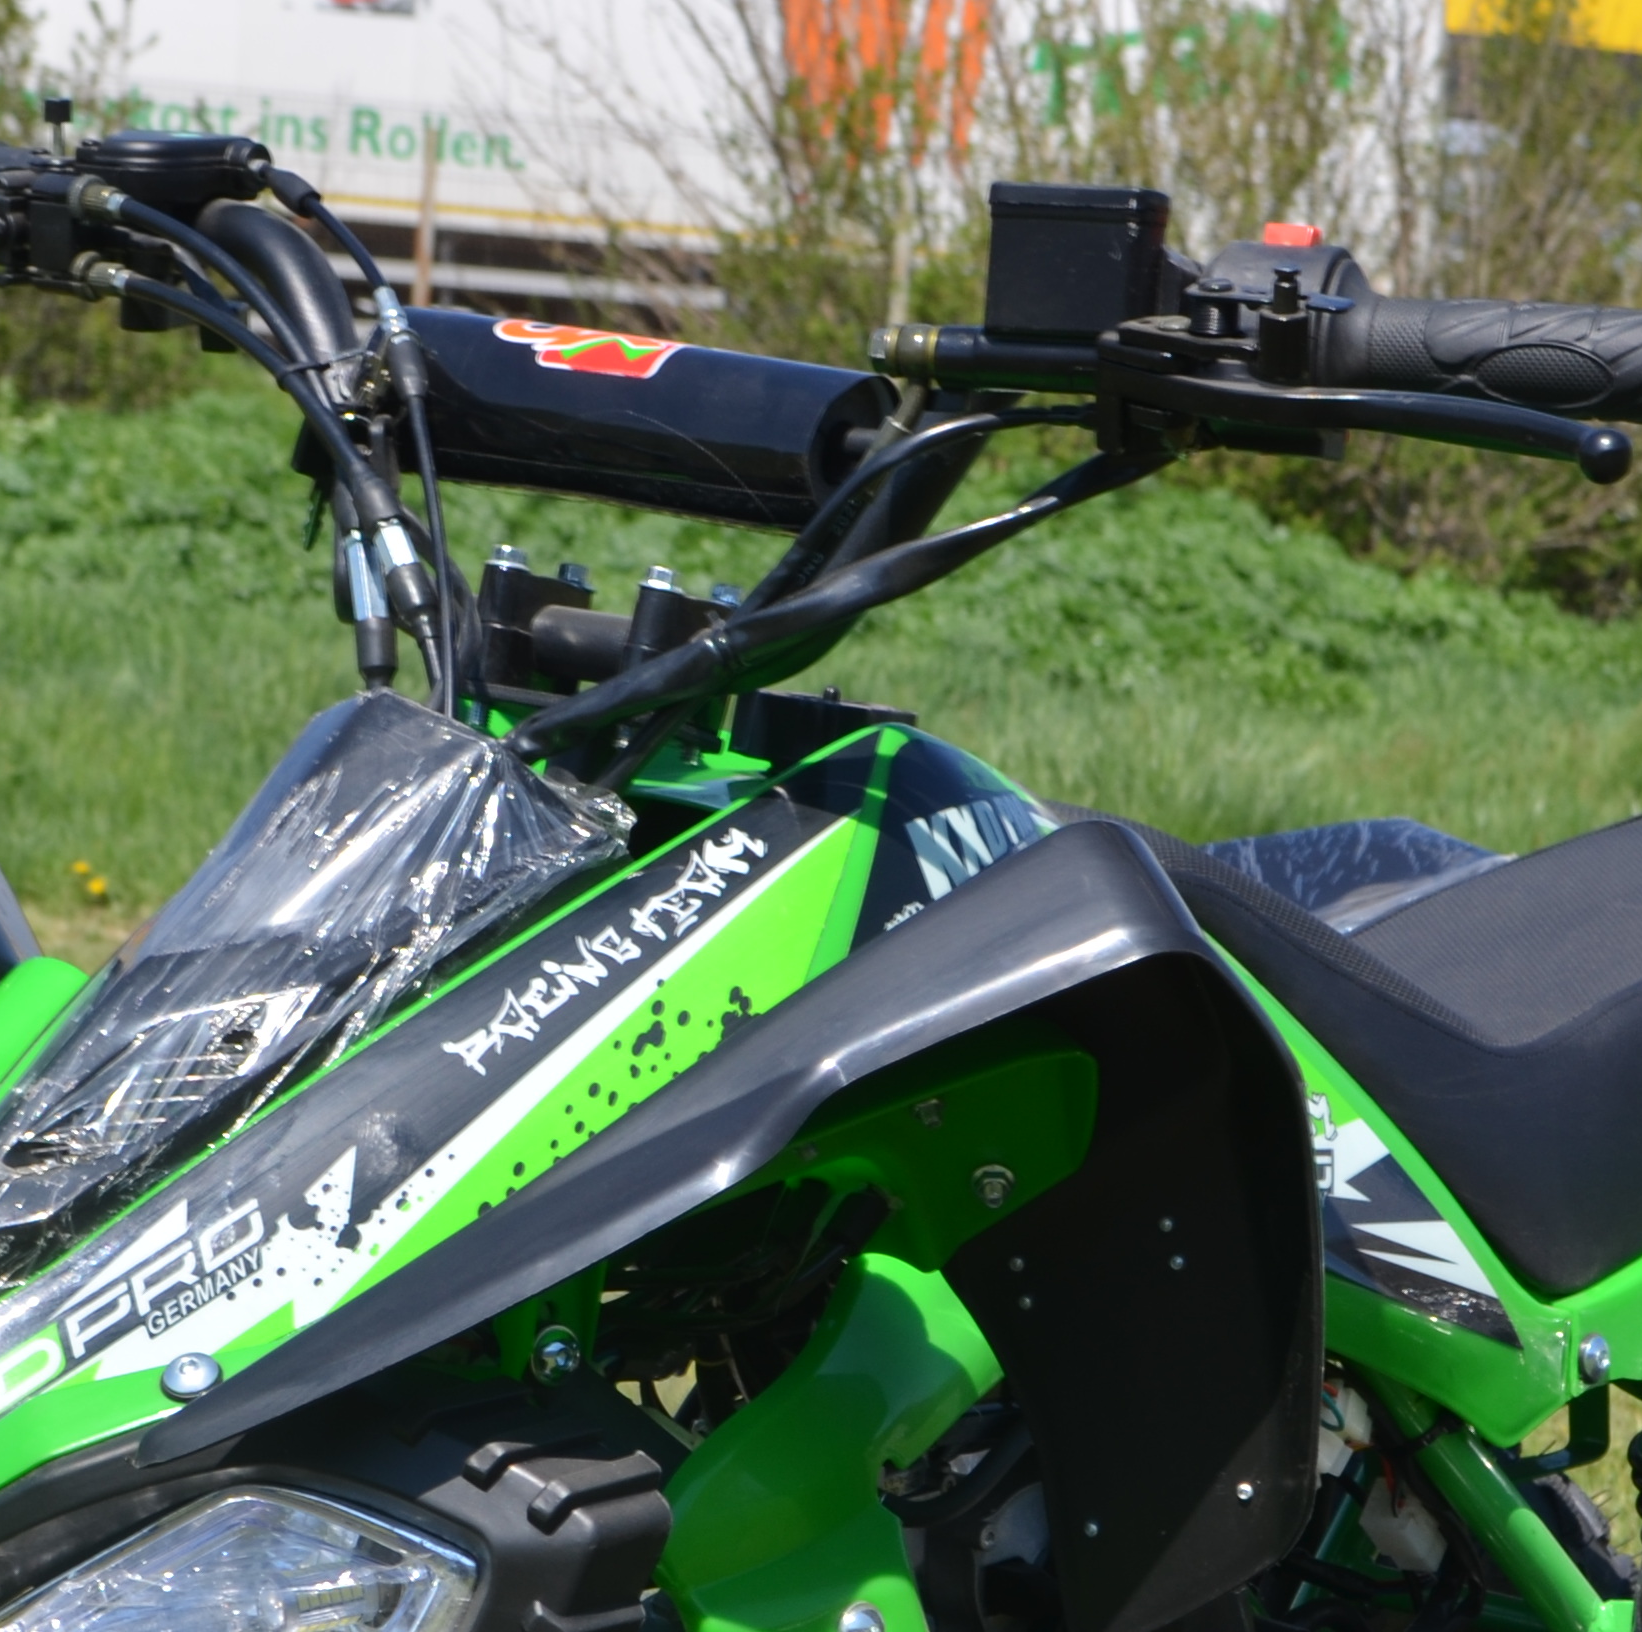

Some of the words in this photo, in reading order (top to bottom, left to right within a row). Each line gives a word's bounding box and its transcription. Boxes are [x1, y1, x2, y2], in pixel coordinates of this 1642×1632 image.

[260, 97, 328, 152] ins
[629, 827, 768, 942] TEAM
[146, 1244, 261, 1336] GERMANY
